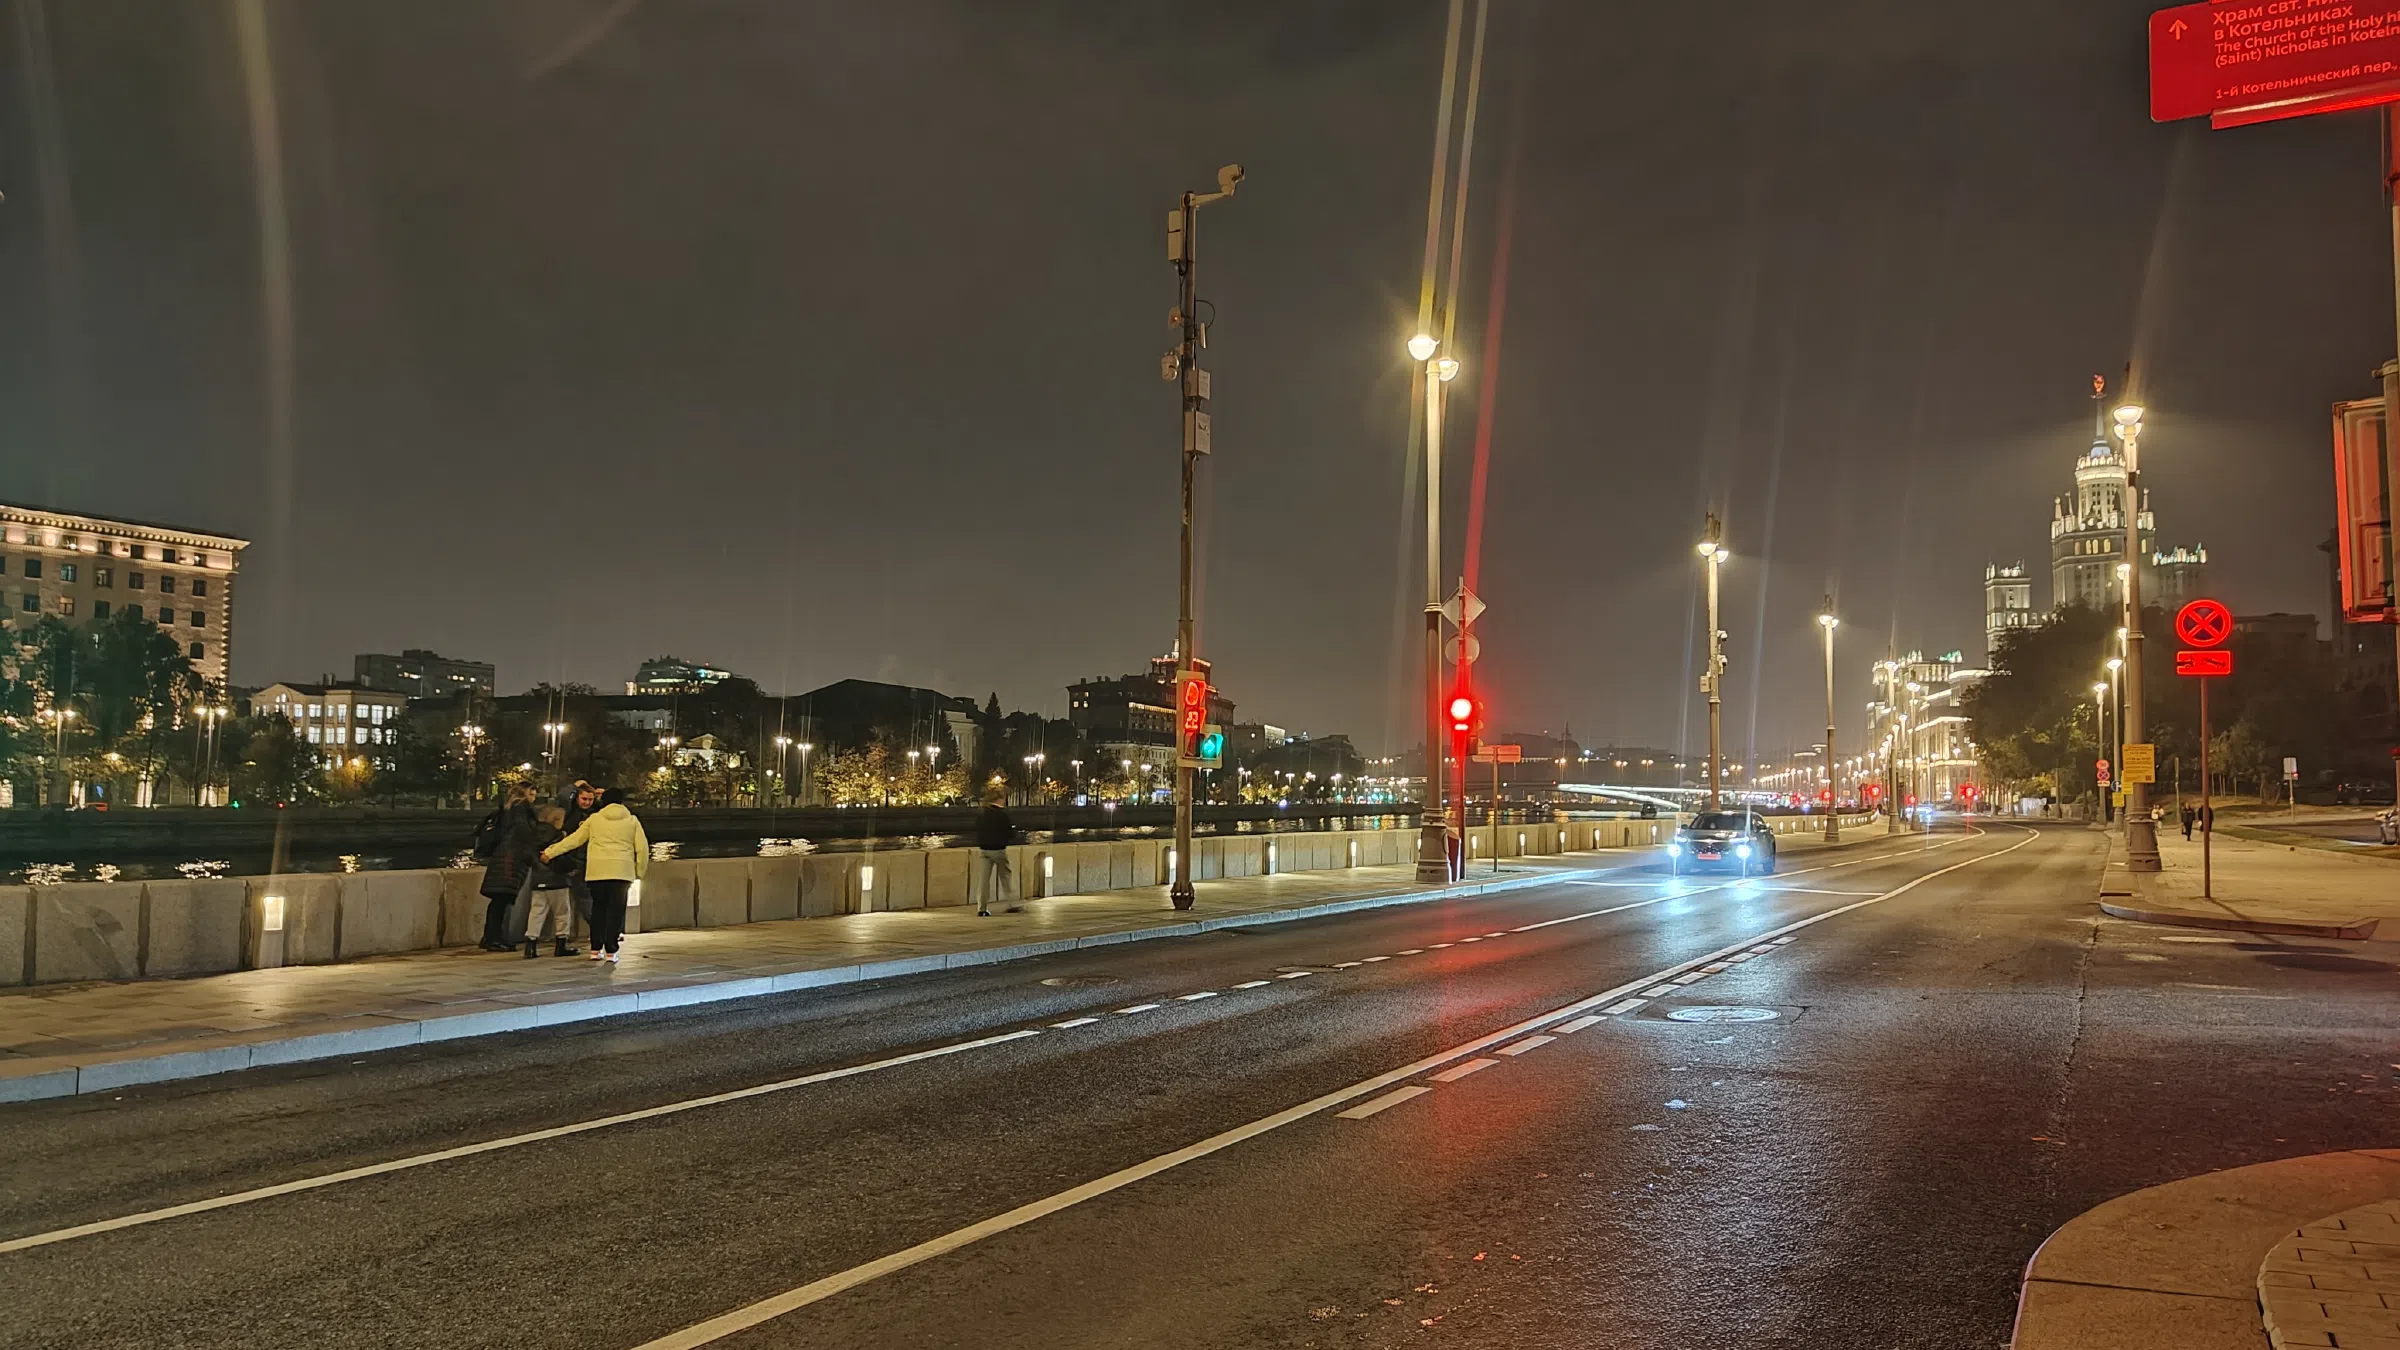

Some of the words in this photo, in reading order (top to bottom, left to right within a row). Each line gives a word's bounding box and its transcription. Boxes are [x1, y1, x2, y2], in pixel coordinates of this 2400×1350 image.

[2213, 6, 2262, 26] Храм
[2267, 0, 2302, 13] свт.
[2214, 30, 2224, 41] в
[2228, 6, 2353, 38] Котельниках
[2215, 41, 2241, 54] The
[2244, 31, 2297, 49] Church
[2300, 26, 2317, 39] of
[2320, 23, 2346, 37] the
[2349, 15, 2383, 29] Holy
[2215, 50, 2261, 69] (Saint)
[2265, 39, 2329, 58] Nicholas
[2332, 34, 2347, 46] in
[2216, 85, 2239, 100] 1-й
[2242, 64, 2360, 95] Котельнический
